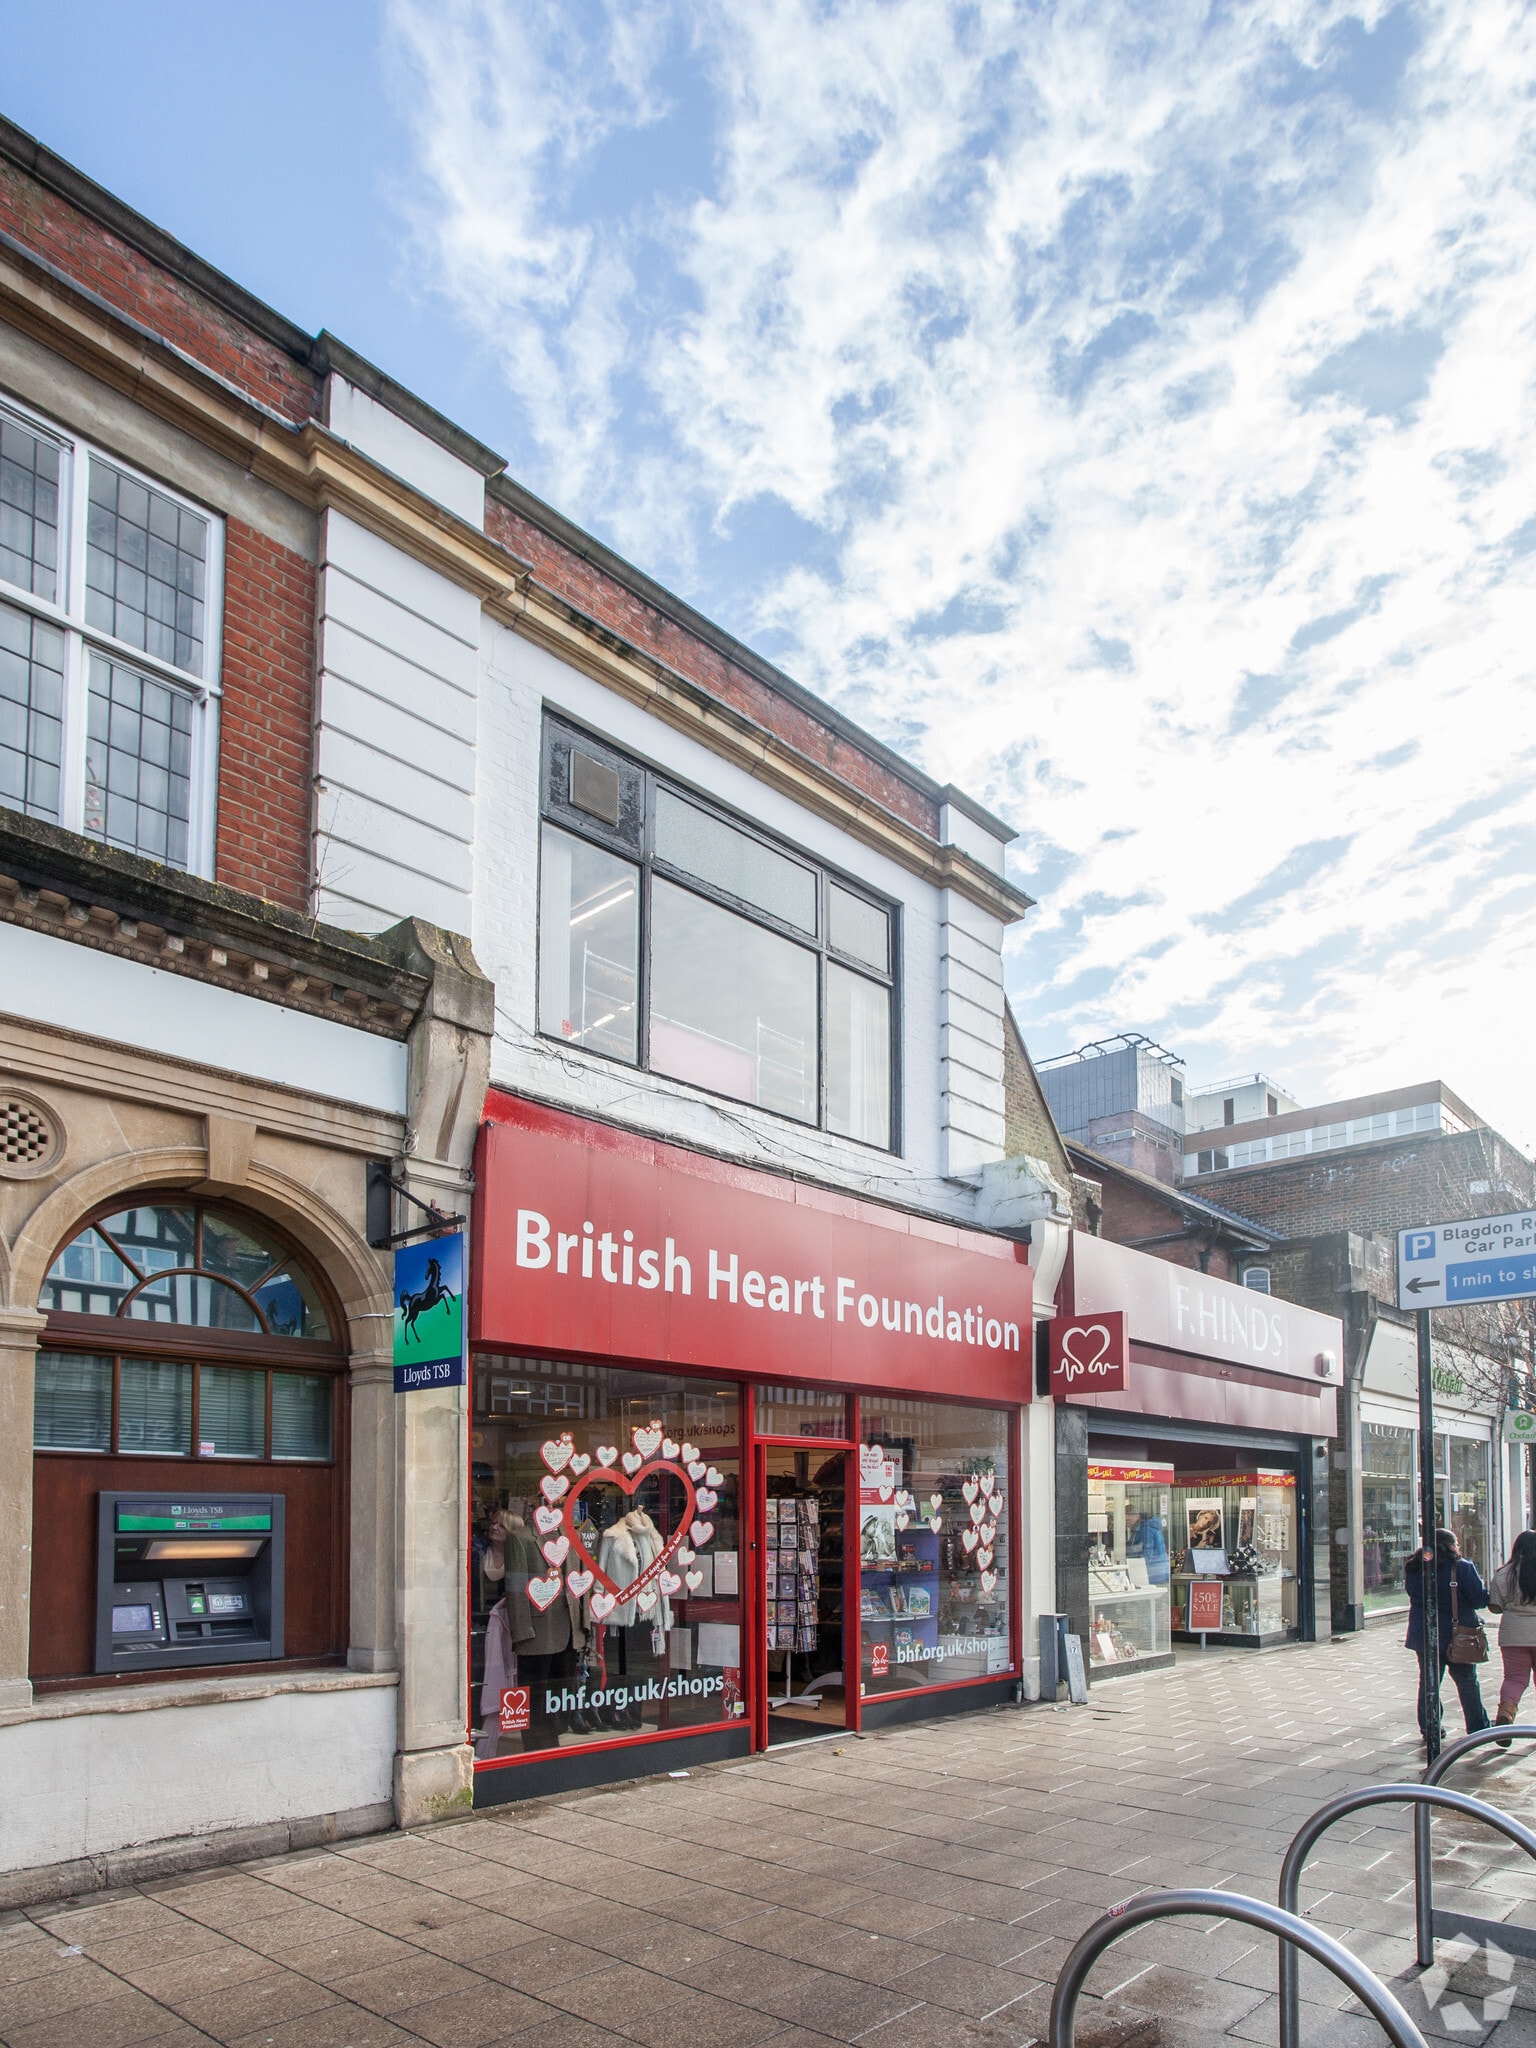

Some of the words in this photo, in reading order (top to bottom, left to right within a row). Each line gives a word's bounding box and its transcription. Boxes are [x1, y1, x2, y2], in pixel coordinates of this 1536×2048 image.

[1443, 1223, 1513, 1241] Blagdon
[1521, 1217, 1536, 1231] R
[1465, 1241, 1495, 1254] Car
[517, 1209, 691, 1296] British
[709, 1249, 826, 1319] Heart
[837, 1276, 1020, 1352] Foundation
[1498, 1270, 1517, 1282] to
[403, 1365, 432, 1386] Lloyds
[433, 1363, 451, 1379] TSB
[1209, 1475, 1227, 1486] PRICE
[1231, 1475, 1248, 1485] SALE
[183, 1506, 208, 1515] Lloyds
[209, 1506, 224, 1514] TSB
[1193, 1603, 1219, 1612] SALE
[897, 1637, 1001, 1664] bhf.org.uk/shops
[545, 1674, 724, 1714] bhf.org.uk/shops
